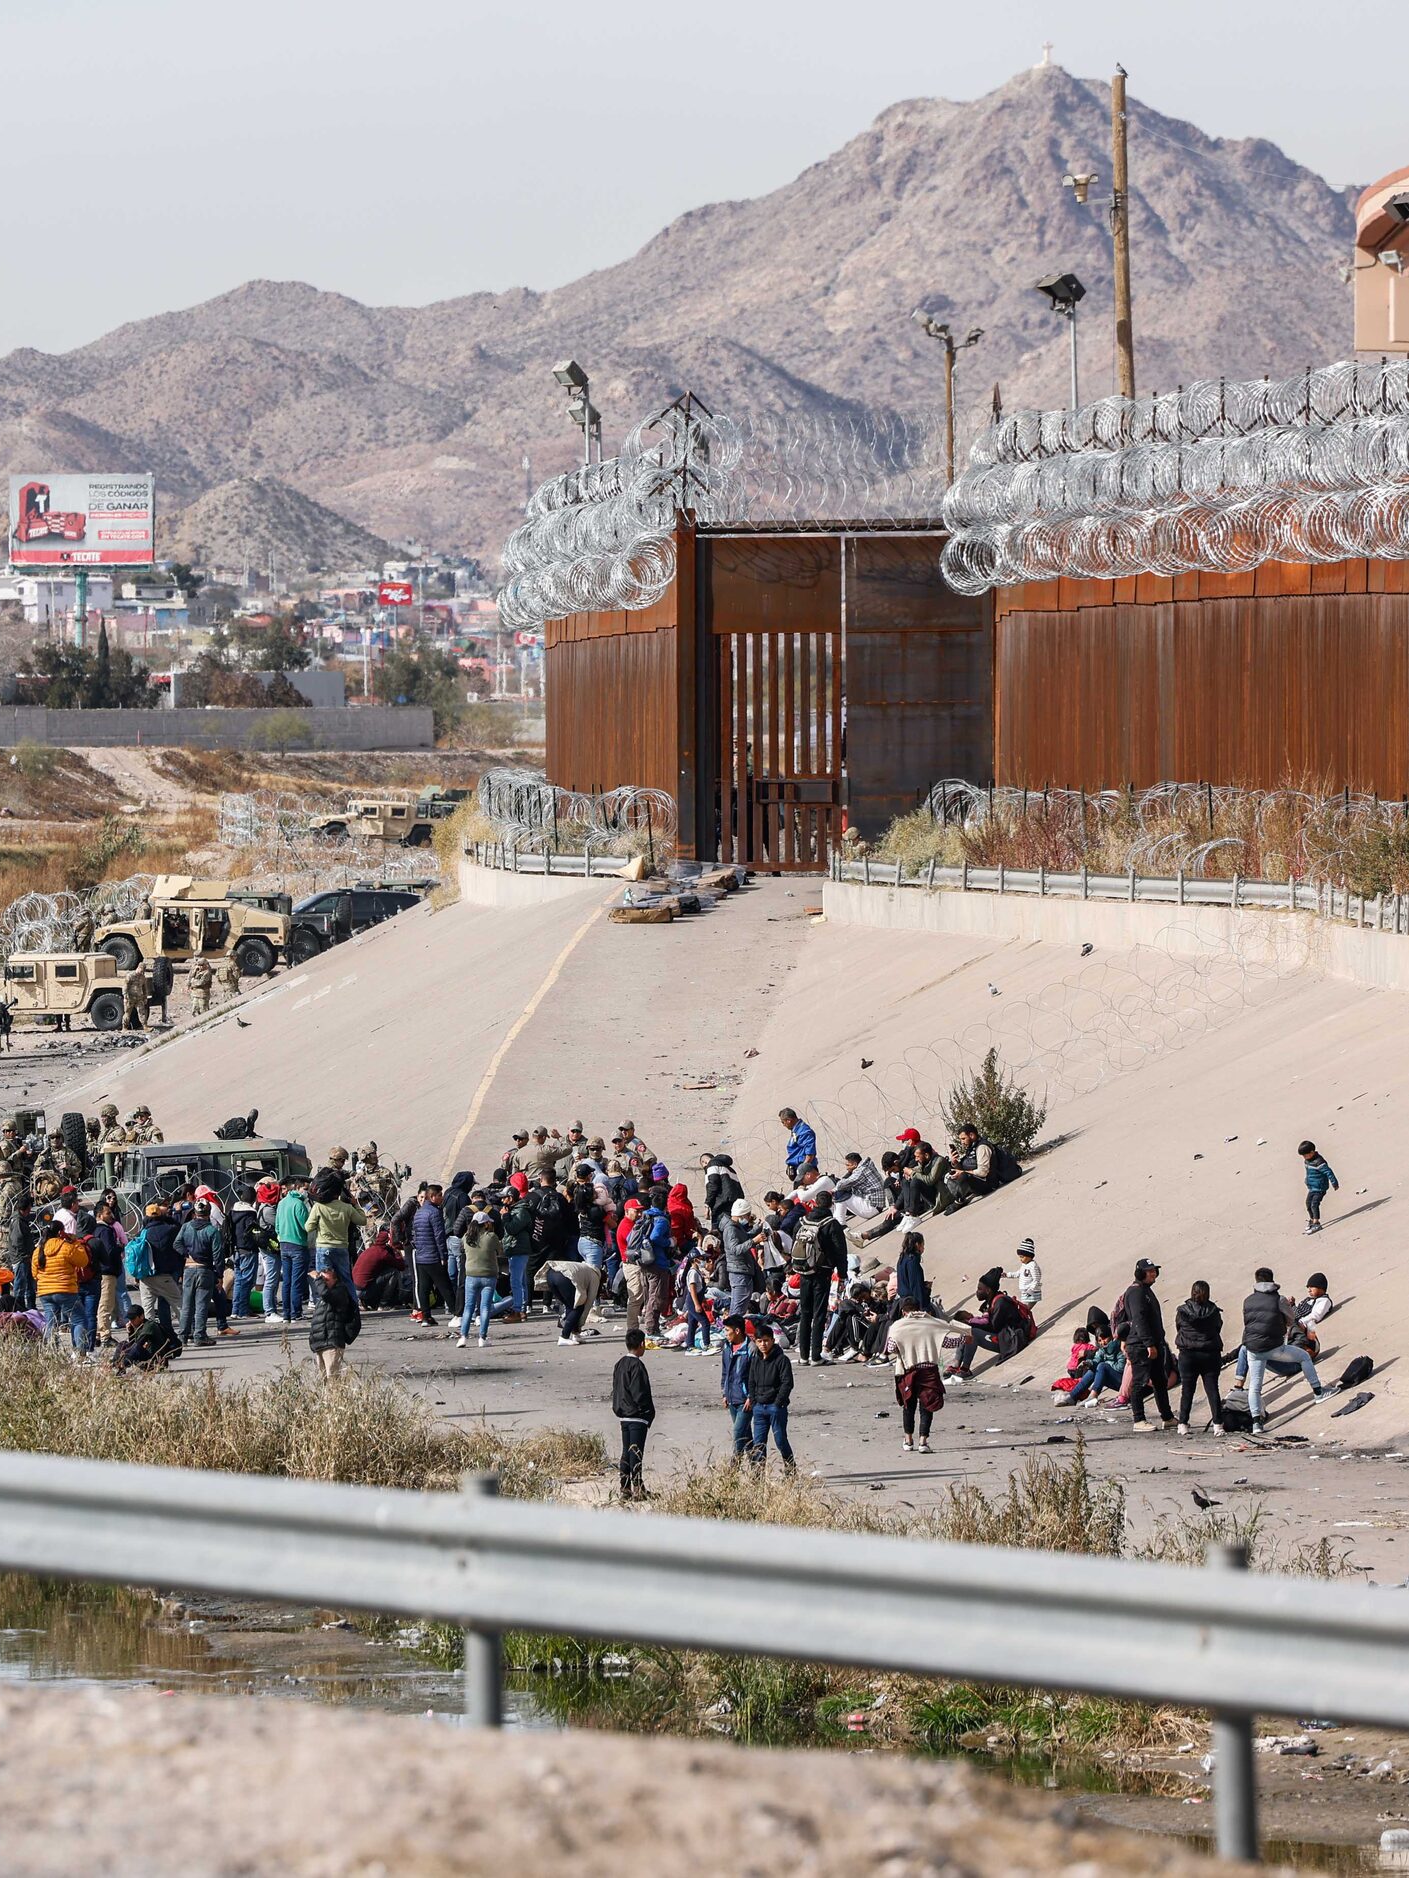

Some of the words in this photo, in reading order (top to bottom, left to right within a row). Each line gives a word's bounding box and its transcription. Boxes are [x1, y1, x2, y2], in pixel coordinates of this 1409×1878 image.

[89, 503, 105, 511] DE
[106, 502, 149, 511] GANAR
[72, 552, 102, 562] TECATE
[532, 1216, 545, 1242] PINK
